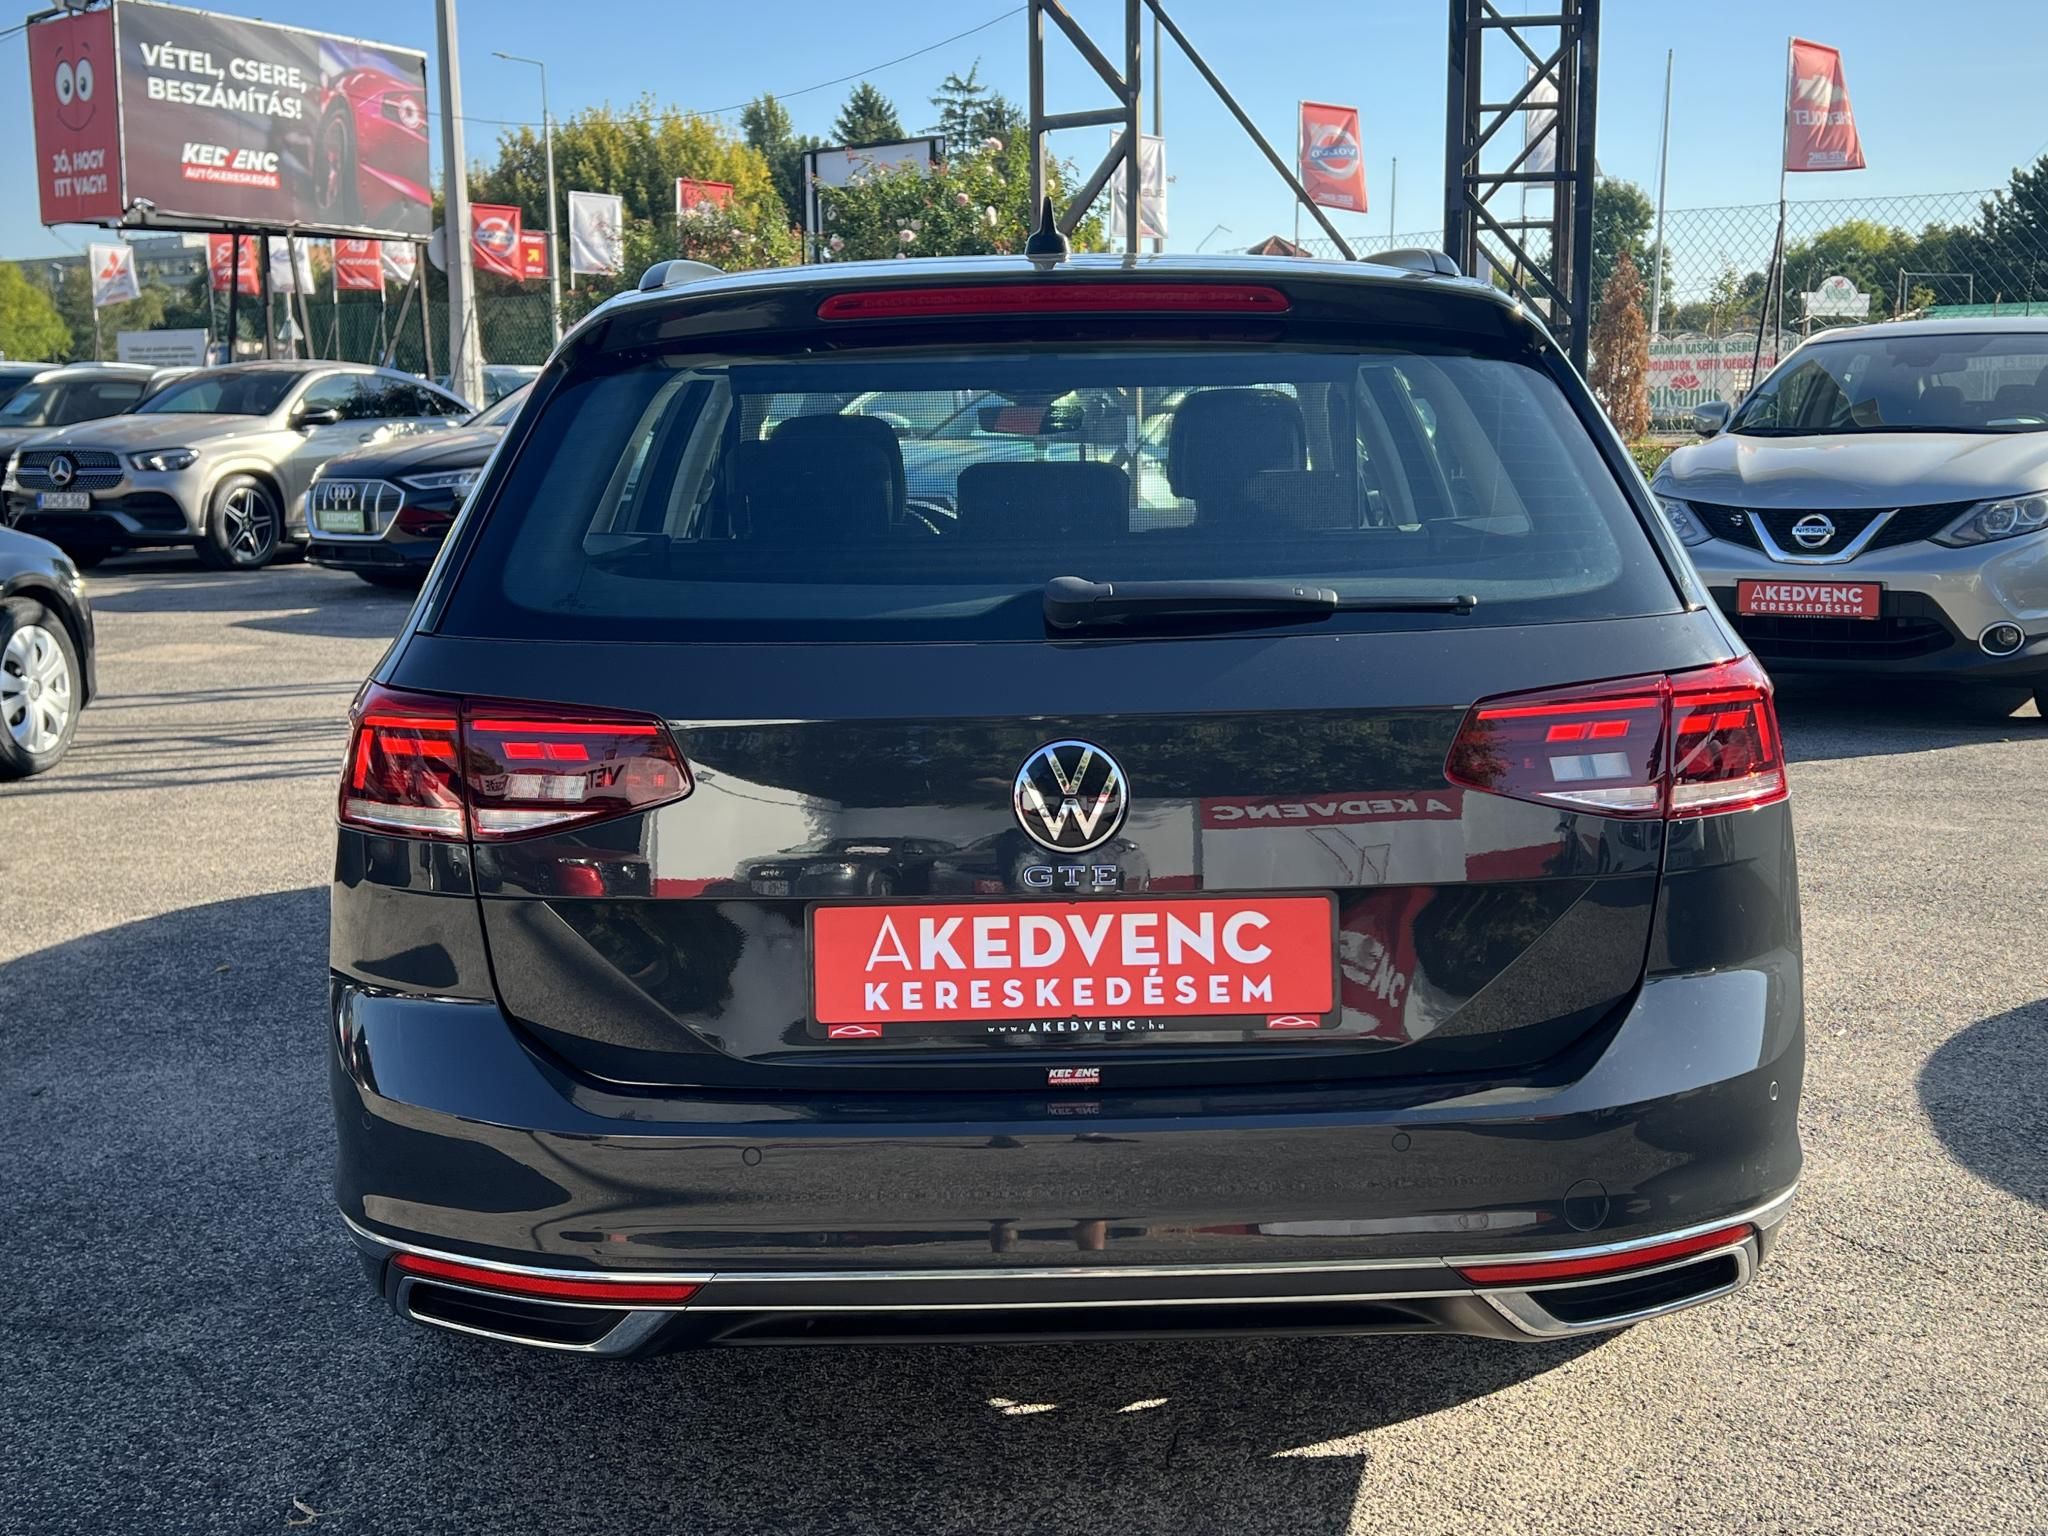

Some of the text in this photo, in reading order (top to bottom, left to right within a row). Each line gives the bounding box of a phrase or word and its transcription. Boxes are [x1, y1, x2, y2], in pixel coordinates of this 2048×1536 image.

[140, 42, 307, 93] VÉTEL, CSERE,
[148, 77, 302, 119] BESZÁMÍTÁS!
[52, 148, 105, 175] JÓ, HOGY
[54, 173, 108, 198] ITT VAGY!
[1751, 601, 1862, 614] KERESKEDÉSEM
[1023, 865, 1117, 887] GTE
[865, 968, 1273, 1011] KERESKEDÉSEM
[988, 1020, 1164, 1033] www.AKEDVENC.hu
